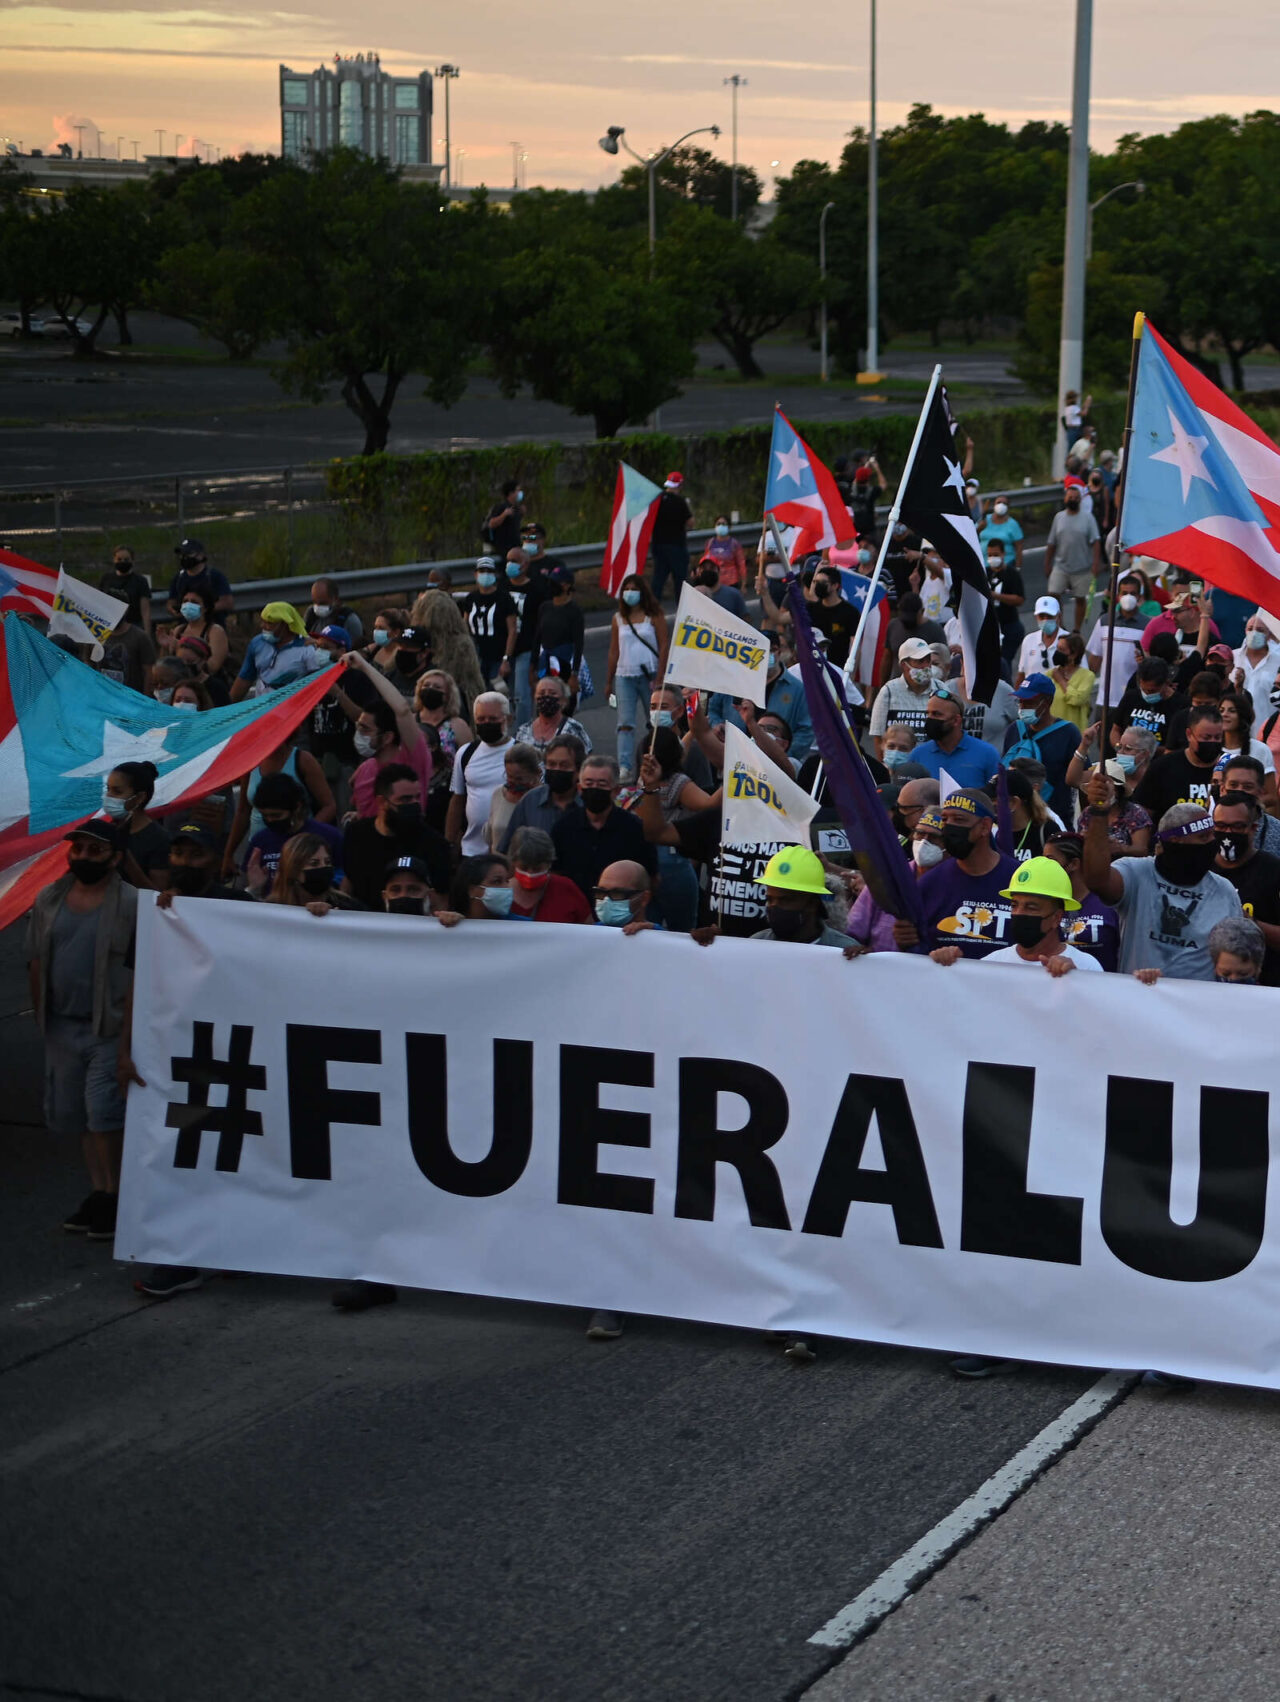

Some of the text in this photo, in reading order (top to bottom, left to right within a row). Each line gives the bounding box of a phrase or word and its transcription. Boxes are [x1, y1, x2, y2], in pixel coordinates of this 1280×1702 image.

[681, 625, 753, 665] TODOS
[723, 631, 758, 646] SACAMOS
[1130, 708, 1166, 724] LUCHA
[1157, 883, 1204, 900] FUCK
[954, 906, 1012, 938] SPT
[1149, 931, 1199, 949] LUMA
